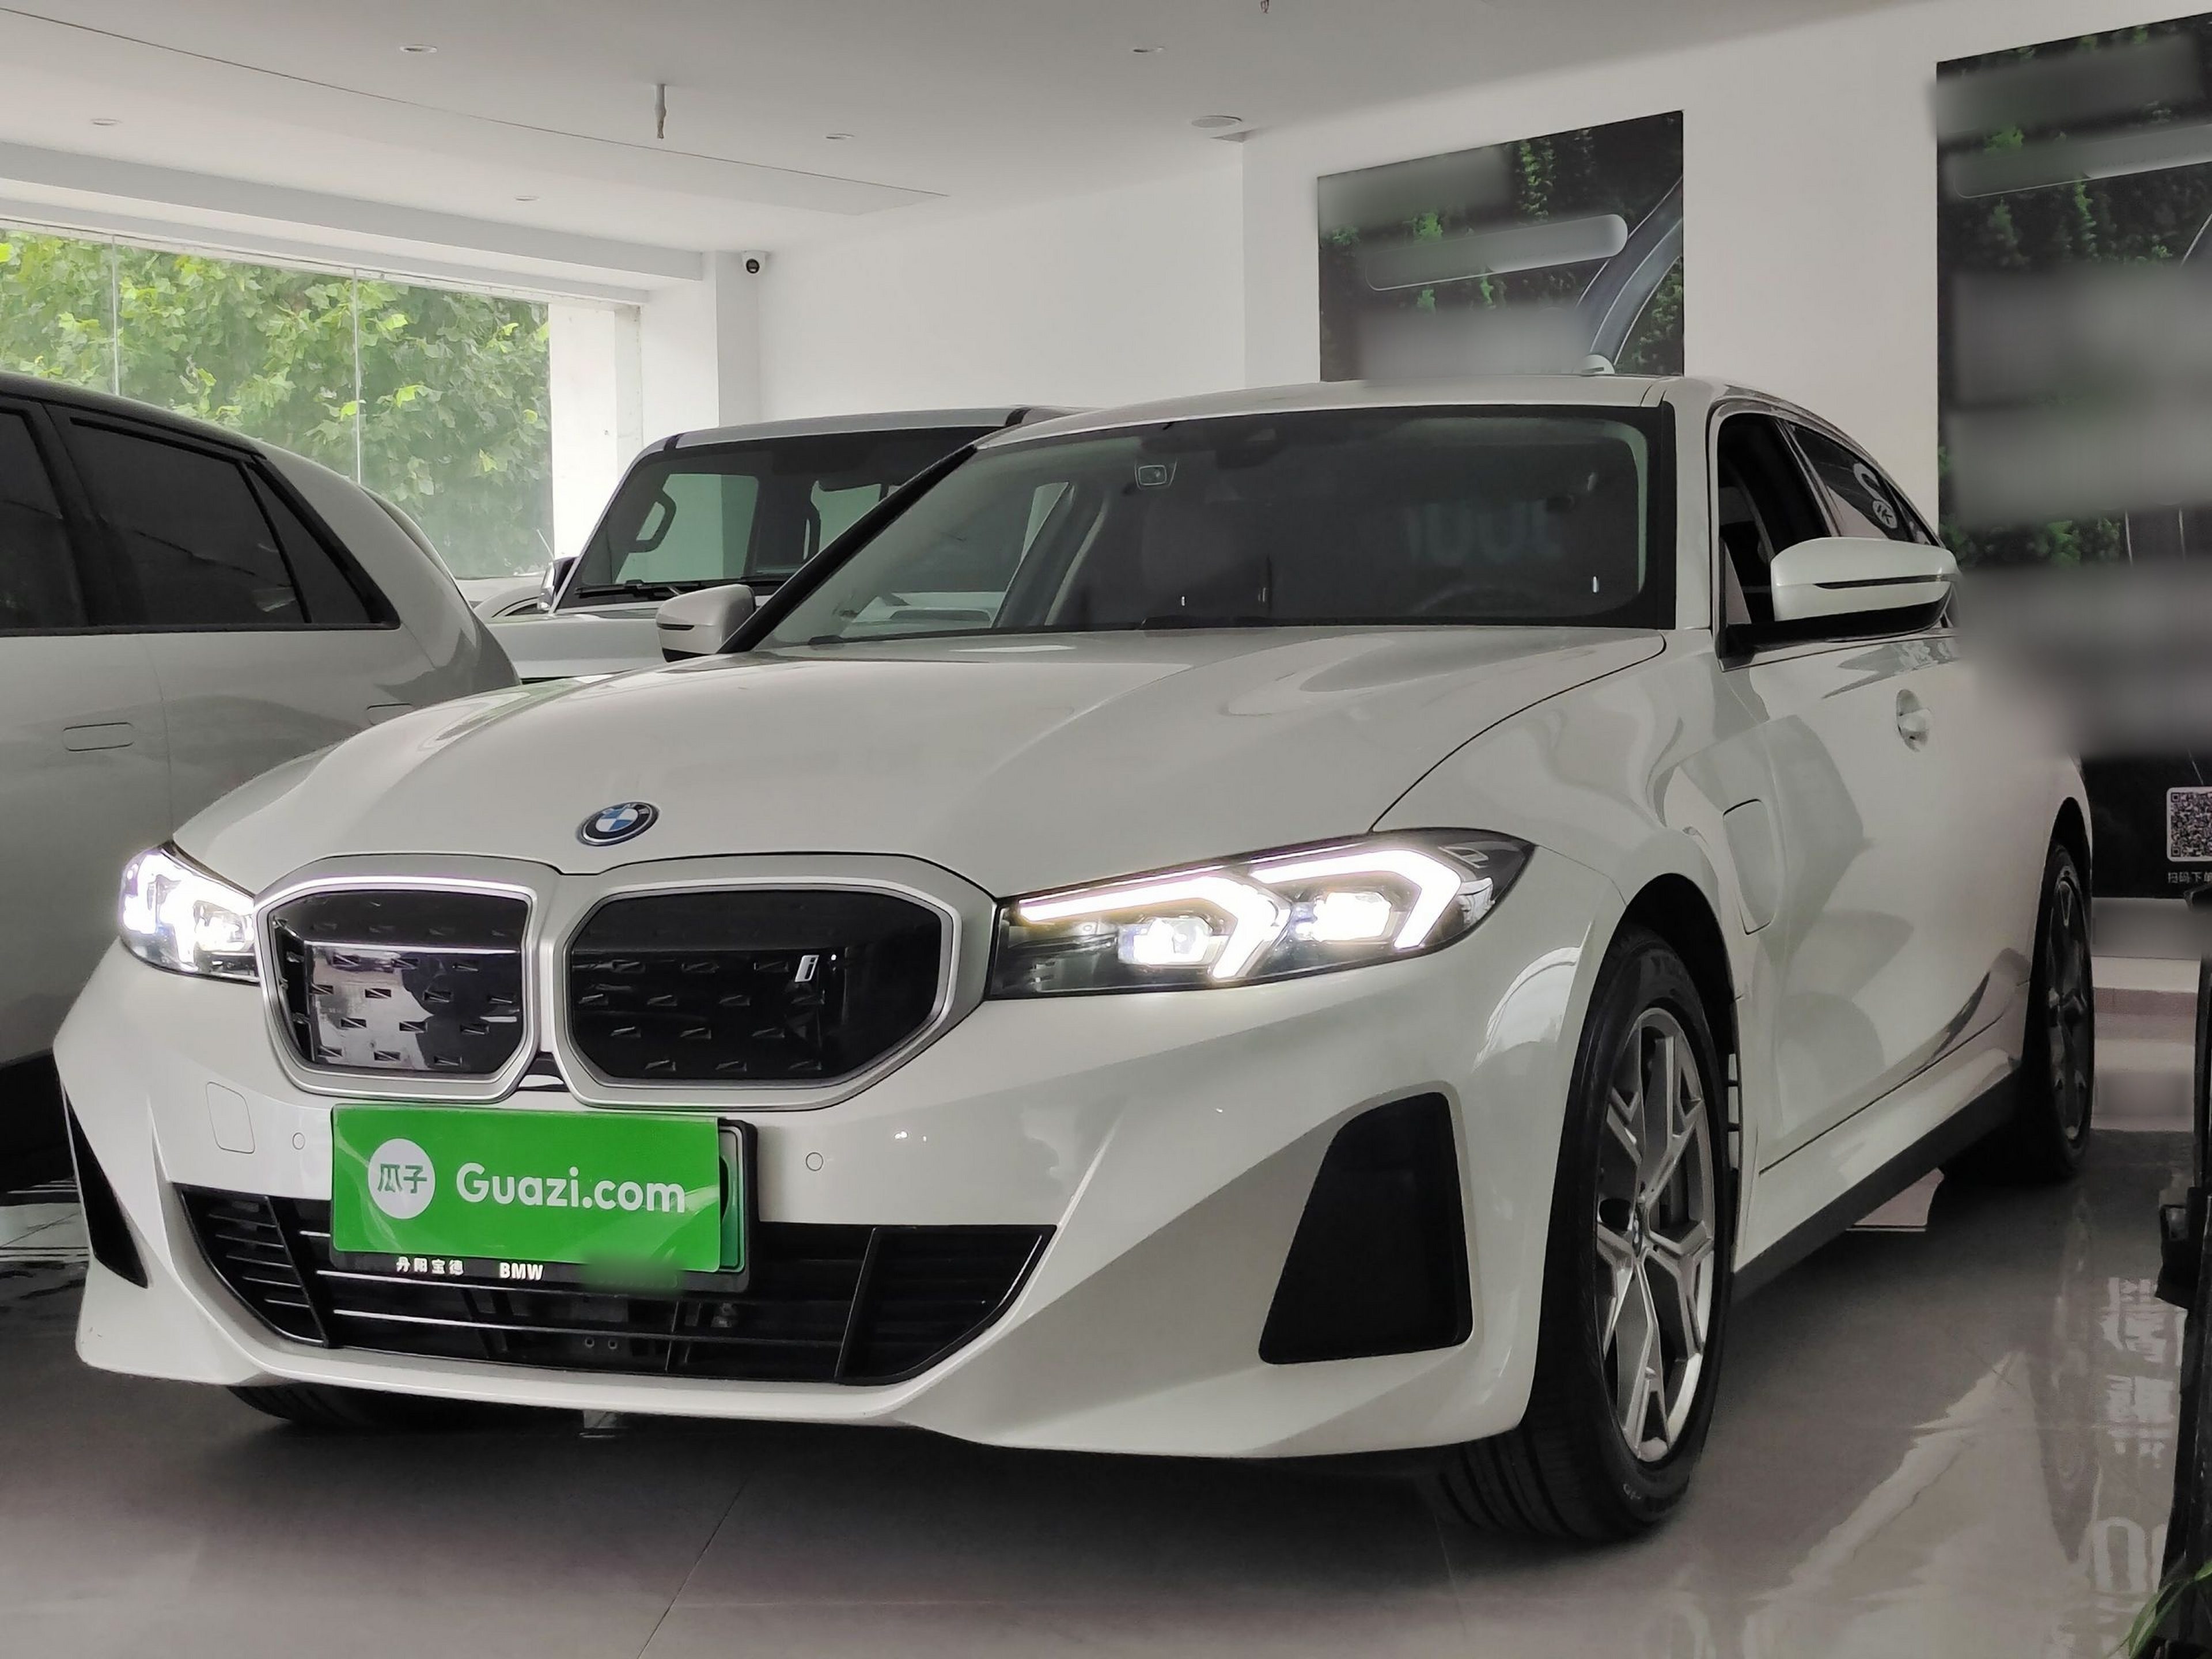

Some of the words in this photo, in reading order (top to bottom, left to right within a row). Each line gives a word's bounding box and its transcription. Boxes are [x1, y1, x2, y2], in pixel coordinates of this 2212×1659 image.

[377, 1164, 427, 1194] 瓜子
[456, 1162, 685, 1213] Guazi.com
[499, 1262, 543, 1281] BMW
